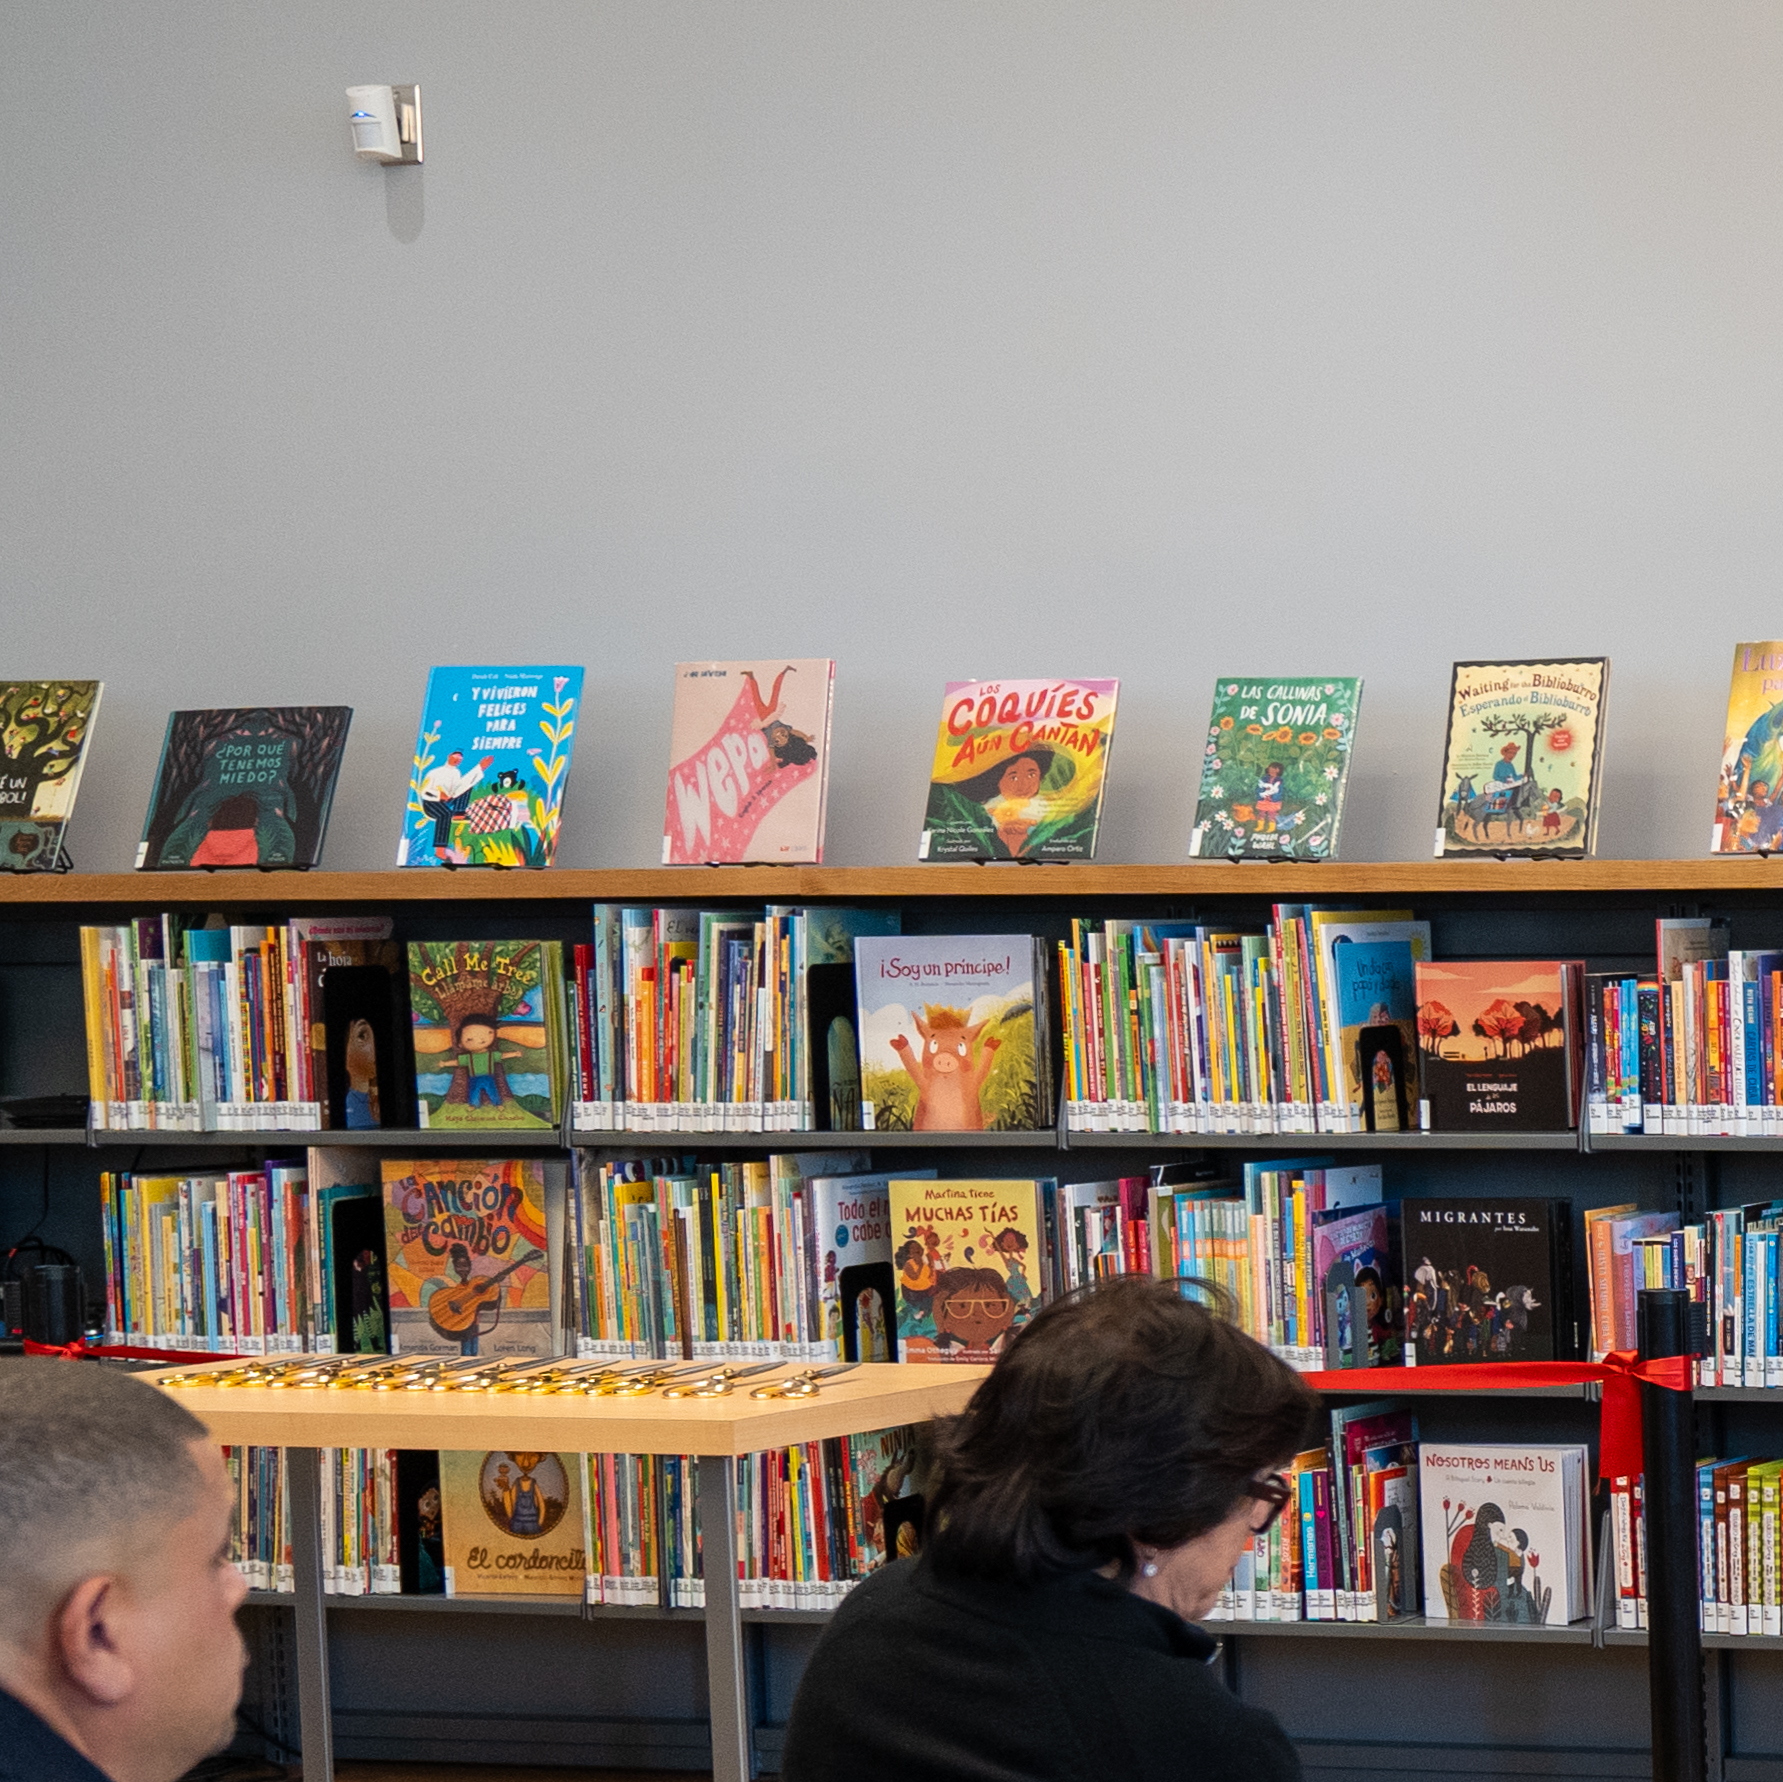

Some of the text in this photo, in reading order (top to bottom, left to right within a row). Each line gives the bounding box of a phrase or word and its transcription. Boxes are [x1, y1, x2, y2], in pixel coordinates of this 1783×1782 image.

[472, 687, 481, 701] Y
[980, 684, 1001, 697] LOS
[1241, 684, 1323, 701] LAS GALLINAS
[1458, 673, 1597, 701] Waiting Biblioburro
[947, 682, 1099, 736] COQUÍES
[1460, 691, 1592, 717] Esperando Biblioburro
[1240, 702, 1327, 726] DE SONIA
[486, 719, 516, 732] PARA
[216, 741, 286, 759] ¿POR QUÉ
[952, 734, 1002, 768] AÚN
[220, 758, 281, 771] TENEMOS
[219, 770, 277, 785] MIEDO?
[422, 953, 531, 986] Call Me Tree
[881, 956, 1011, 980] ¡Soy un príncipe!
[1467, 1083, 1518, 1092] EL LENGUAJE
[1470, 1099, 1517, 1114] PÁJAROS
[925, 1189, 967, 1200] Martina
[838, 1201, 880, 1220] Todo el
[905, 1202, 1019, 1223] MUCHAS TÍAS
[1420, 1210, 1526, 1224] MIGRANTES
[852, 1222, 880, 1242] cabe
[1747, 1279, 1757, 1338] ESTRELLA DE
[1426, 1454, 1555, 1472] NOSOTROS MEANS US
[467, 1547, 491, 1570] El
[1281, 1537, 1290, 1562] RIZOS
